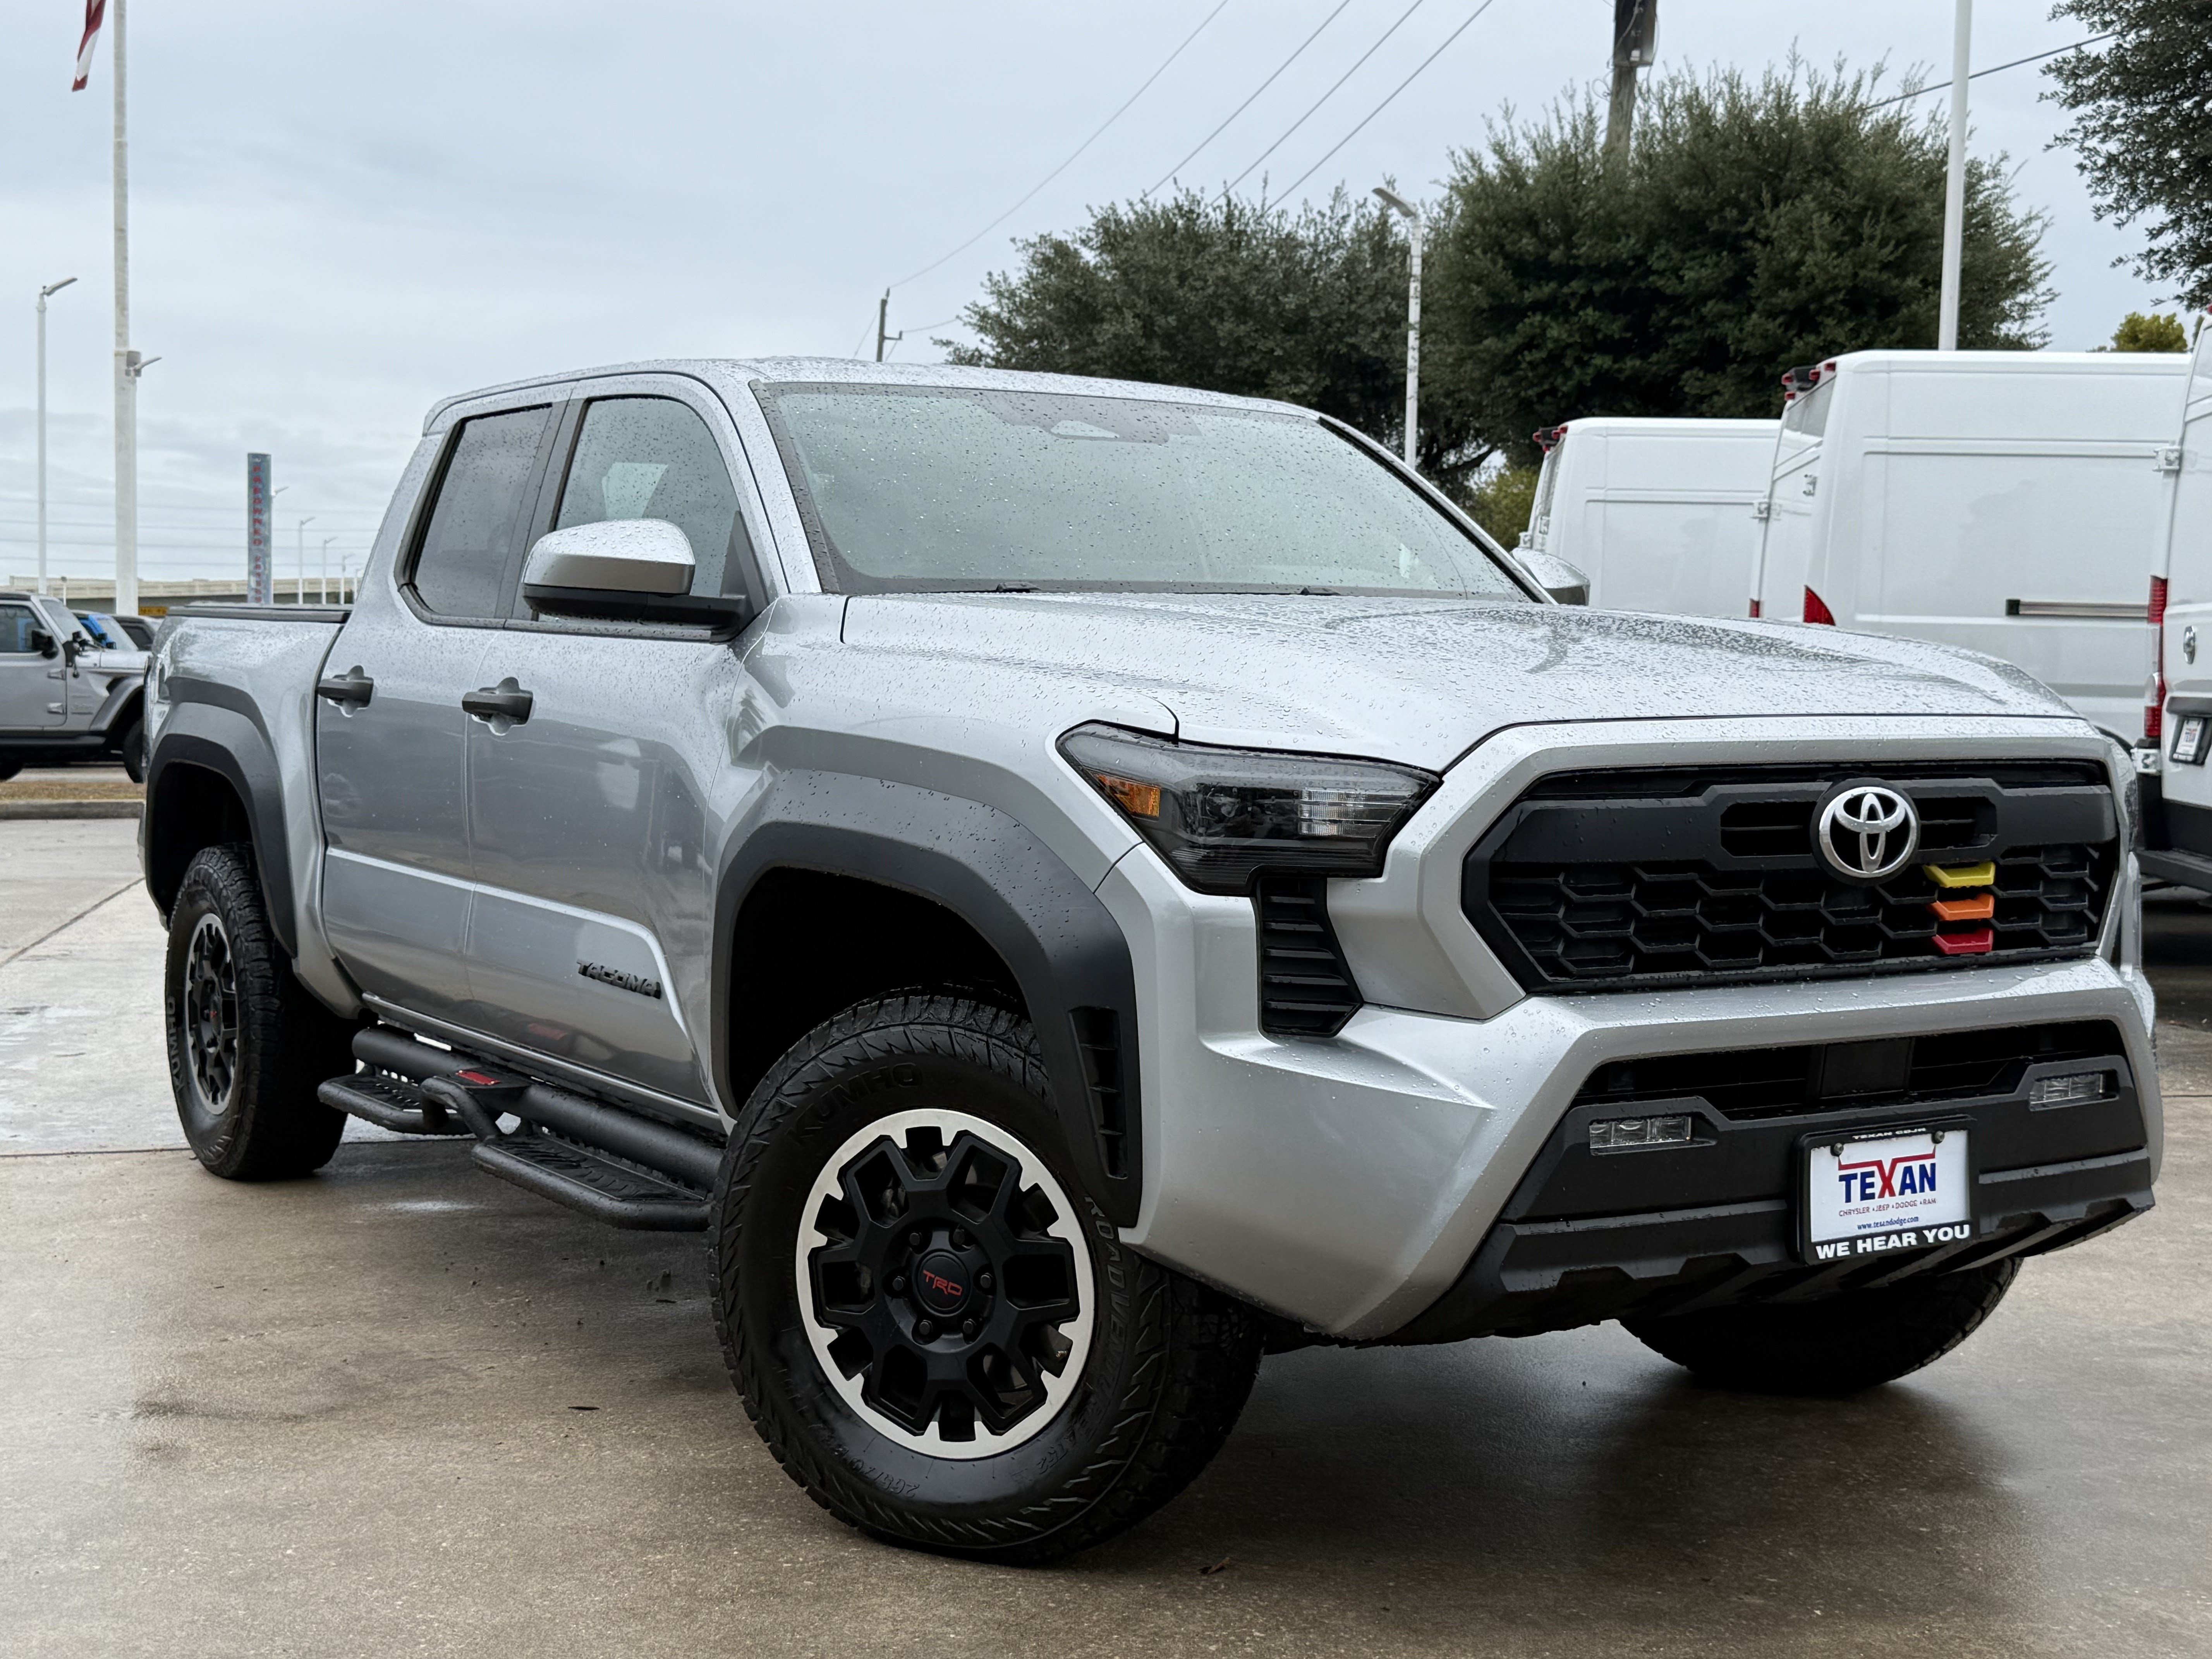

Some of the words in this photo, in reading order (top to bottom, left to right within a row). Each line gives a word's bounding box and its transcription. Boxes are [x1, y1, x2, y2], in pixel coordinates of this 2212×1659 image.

[577, 959, 661, 1000] TACOMA
[785, 1062, 924, 1146] KUMHO
[1838, 1154, 1936, 1203] TEXAN
[1839, 1207, 1870, 1216] CHRYSLER
[1896, 1200, 1917, 1209] DODGE
[1857, 1216, 1919, 1230] www.texandodge.com
[1816, 1242, 1850, 1259] WE
[1857, 1232, 1917, 1253] HEAR
[1923, 1224, 1970, 1243] YOU
[923, 1269, 963, 1296] TRD
